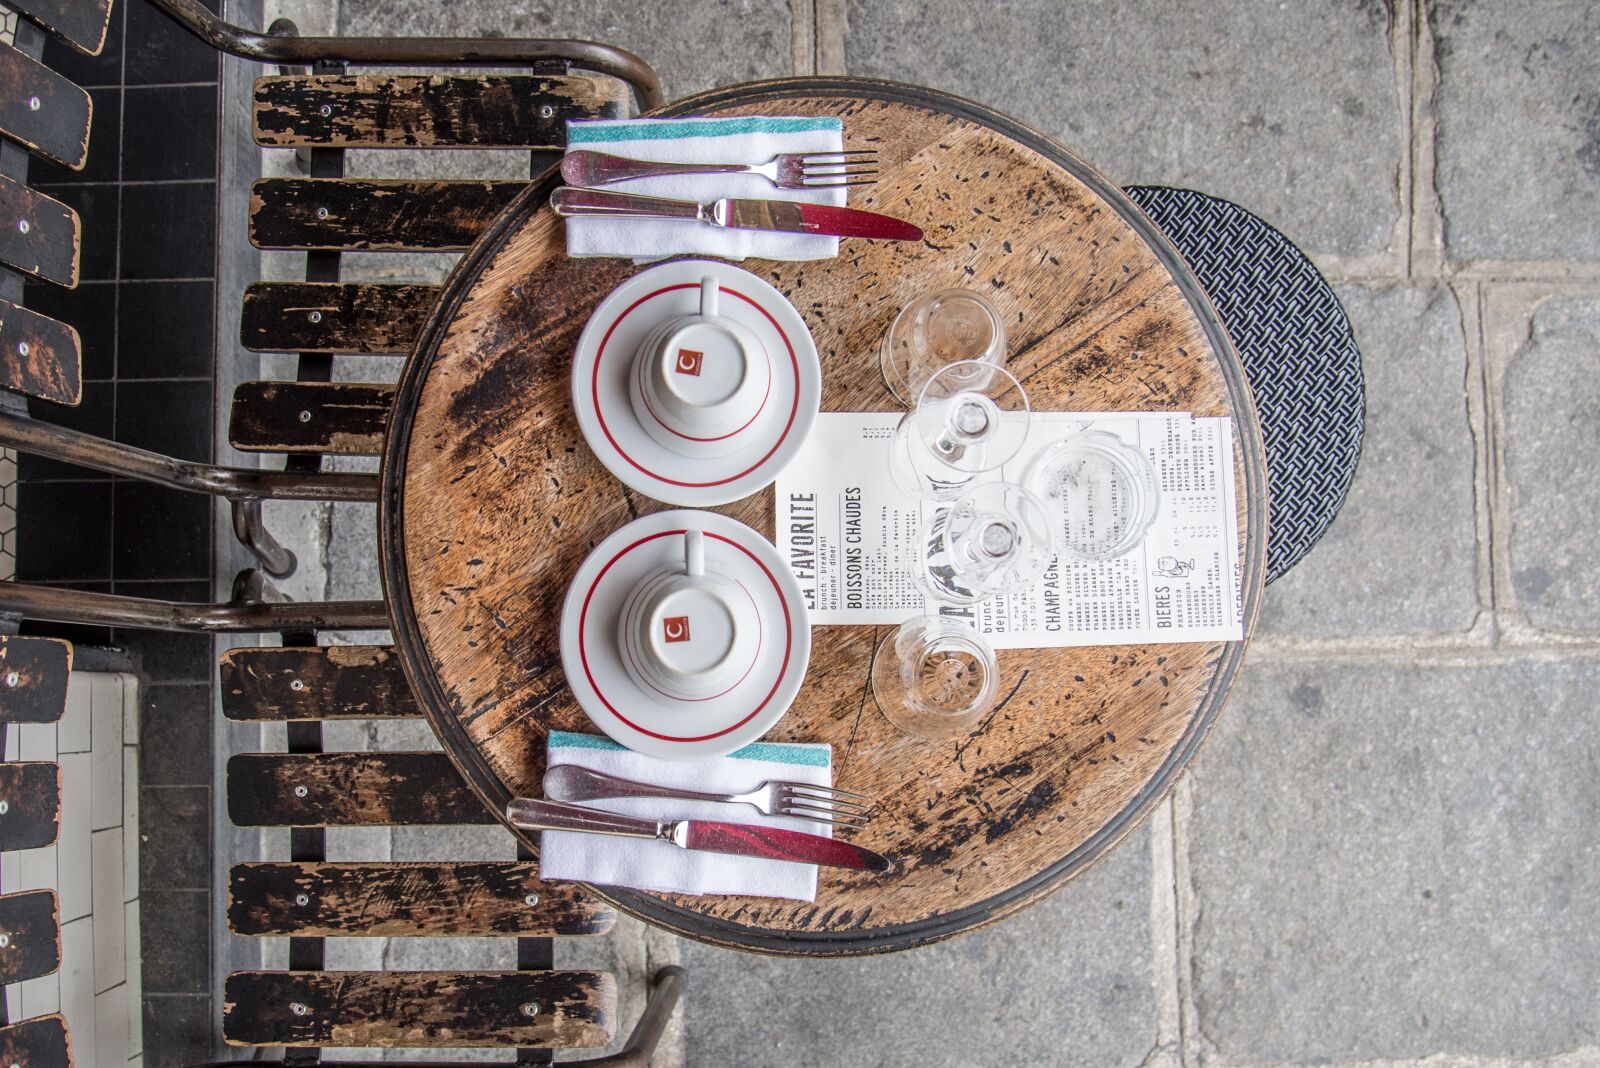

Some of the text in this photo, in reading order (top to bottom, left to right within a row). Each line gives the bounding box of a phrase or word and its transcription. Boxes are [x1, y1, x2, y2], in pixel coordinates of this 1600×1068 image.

[790, 493, 815, 579] FAVORITE
[819, 535, 827, 574] breakfast
[845, 487, 862, 609] BOISSONS CHAUDES
[820, 583, 828, 610] brunch
[1043, 553, 1061, 631] CHAMPAGN
[1154, 586, 1172, 628] BIERES
[982, 601, 993, 633] brunc
[995, 594, 1006, 633] dejeun
